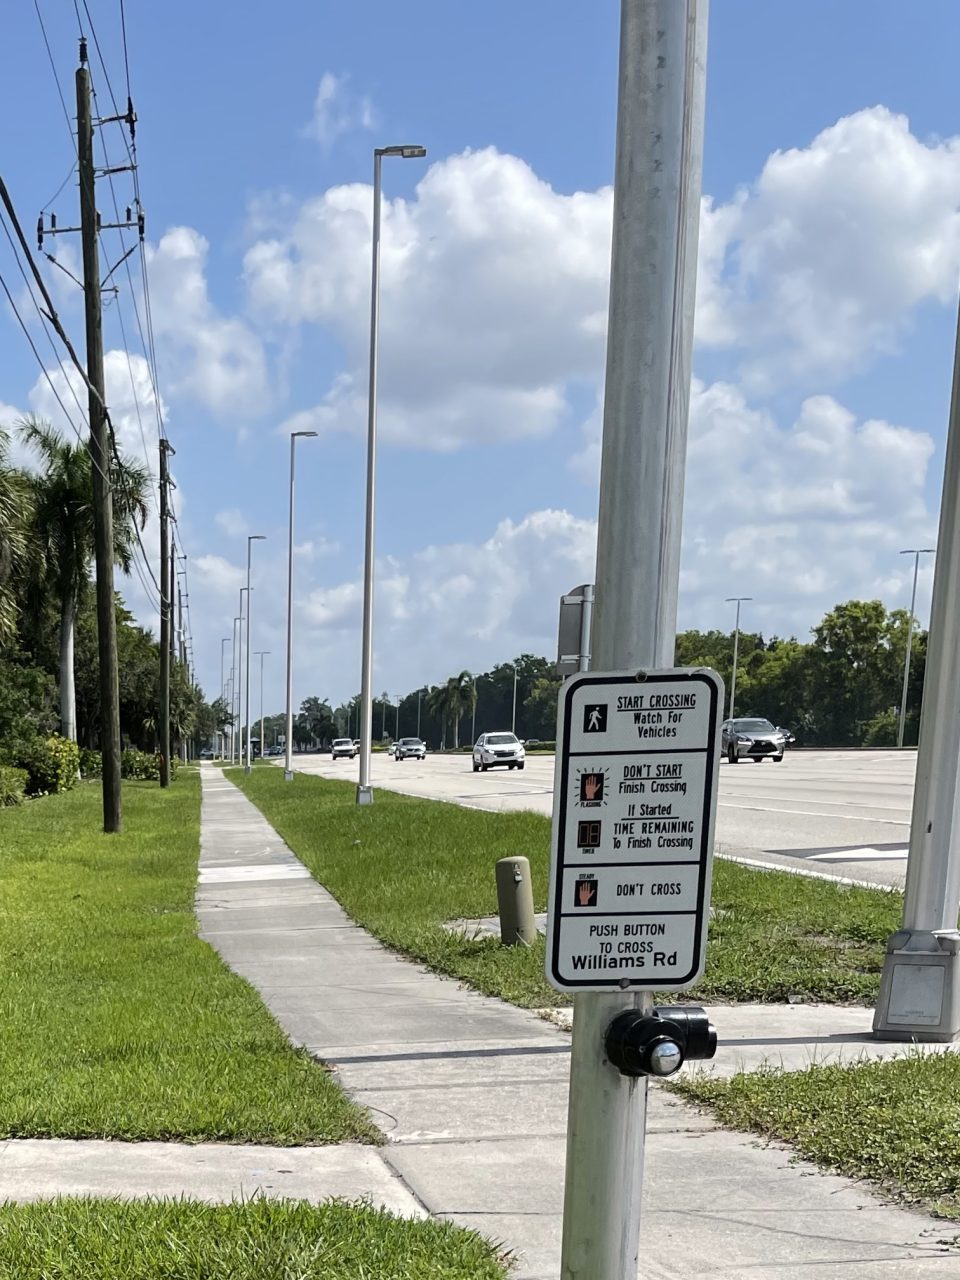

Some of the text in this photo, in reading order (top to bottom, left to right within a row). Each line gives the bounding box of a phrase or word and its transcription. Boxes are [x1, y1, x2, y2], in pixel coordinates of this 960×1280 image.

[617, 694, 696, 709] START CROSSING
[633, 711, 682, 725] Watch For
[637, 726, 677, 738] Vehicles
[623, 764, 682, 778] DON'T START
[619, 781, 687, 795] Finish Crossing
[628, 803, 671, 816] If Started
[614, 821, 694, 835] TIME REMAINING
[613, 835, 694, 850] To Finish Crossing
[616, 883, 681, 896] DON'T CROSS
[589, 923, 665, 937] PUSH BUTTON
[599, 941, 654, 954] TO CROSS
[571, 951, 678, 970] Williams Rd
